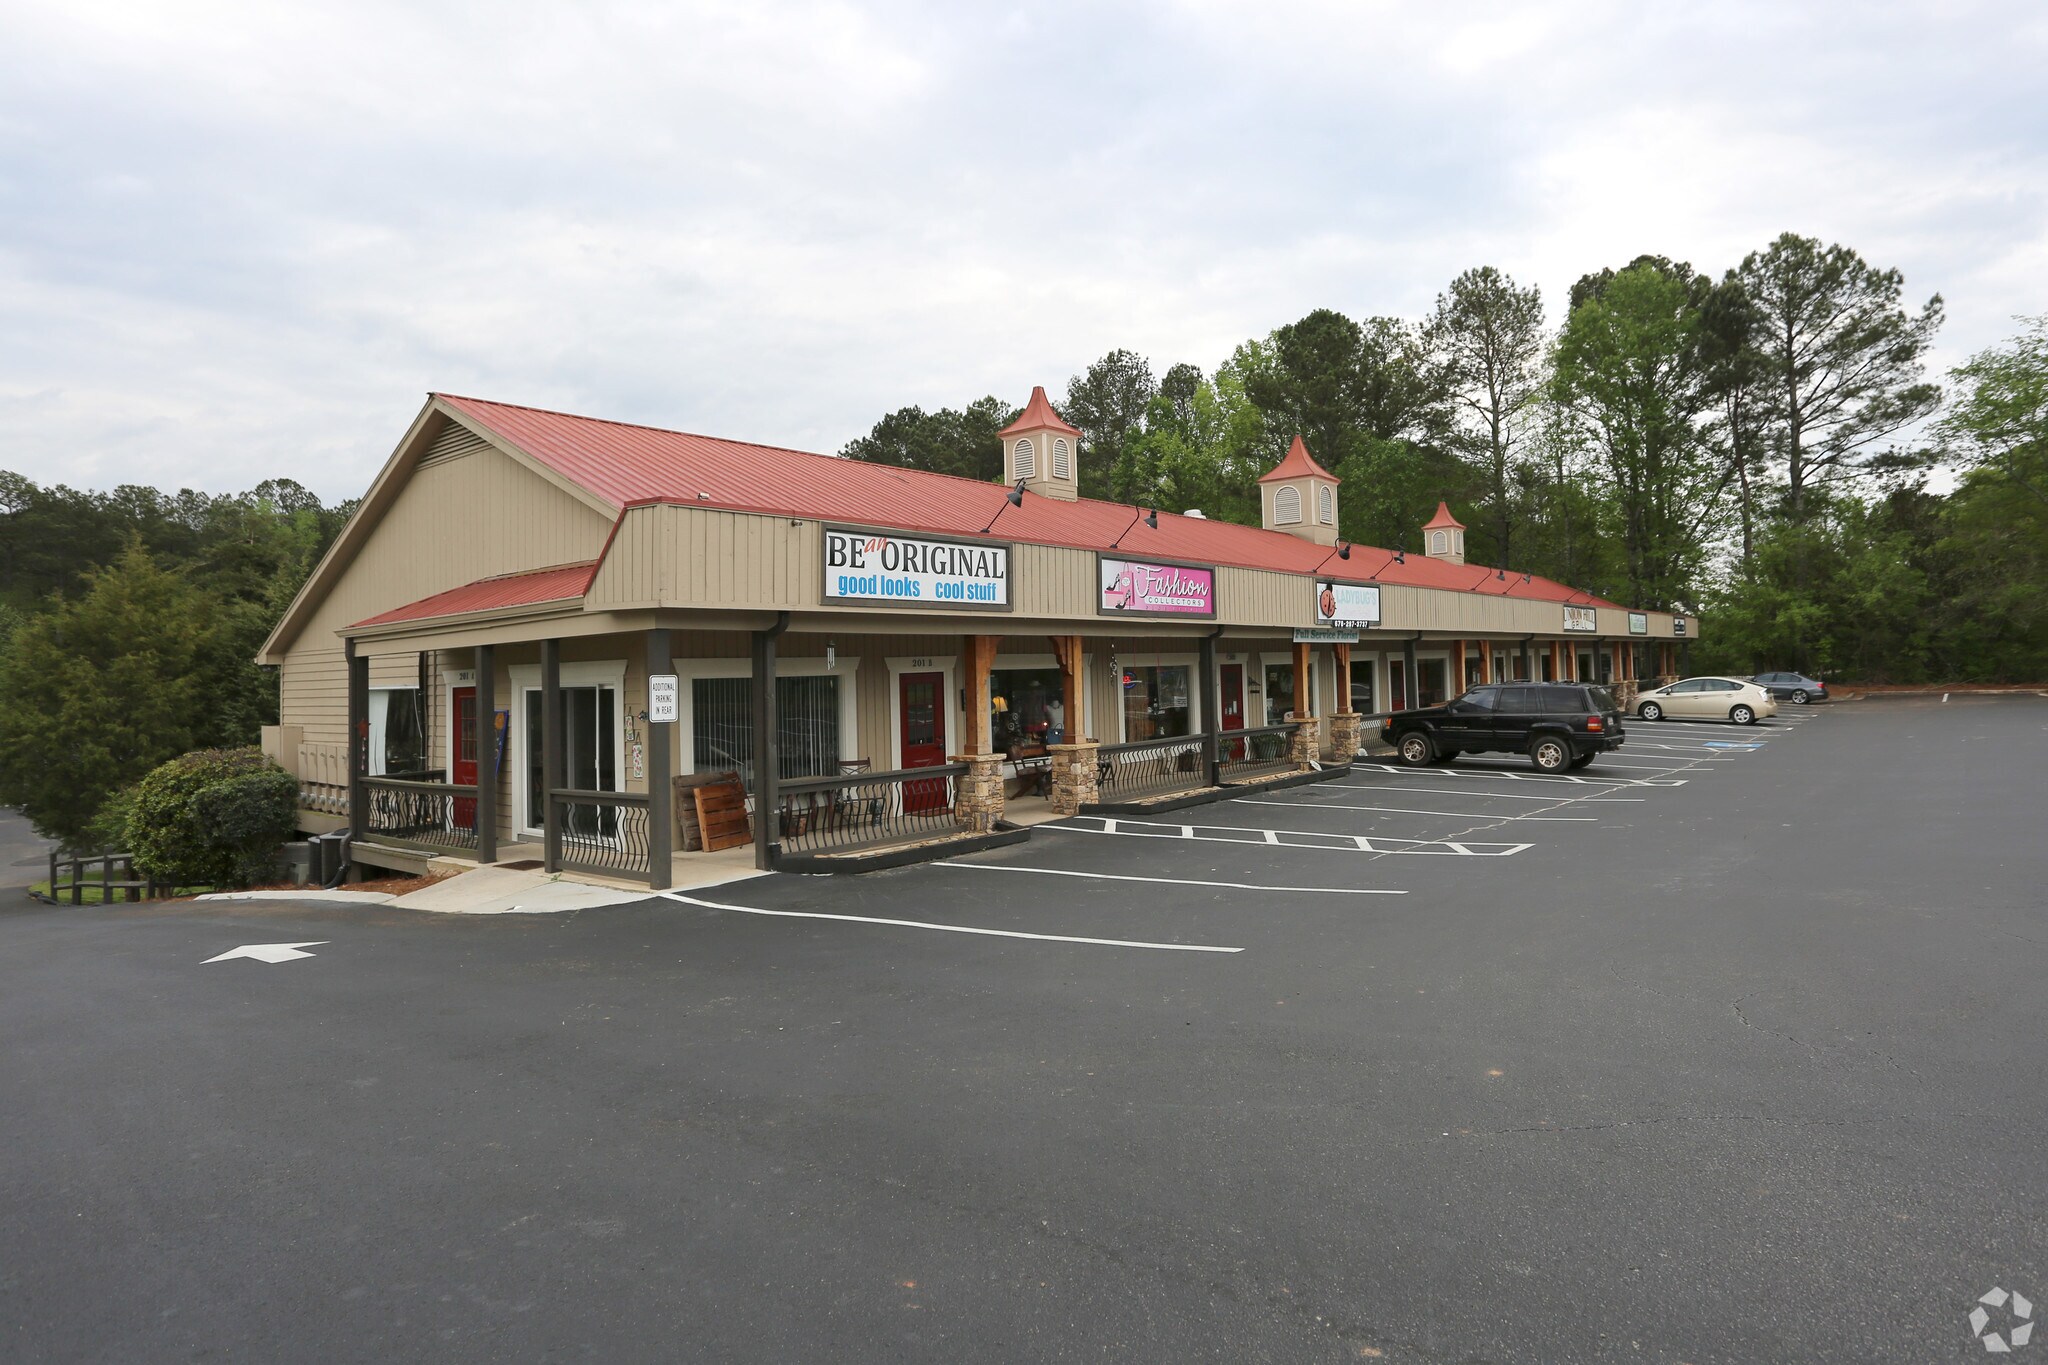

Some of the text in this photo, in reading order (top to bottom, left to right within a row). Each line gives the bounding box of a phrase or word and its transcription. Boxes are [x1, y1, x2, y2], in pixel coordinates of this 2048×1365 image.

[828, 535, 1004, 579] BE an ORIGINAL
[1135, 565, 1209, 598] Fashion
[838, 575, 997, 601] good looks cool stuff
[1148, 597, 1202, 606] COLLECTORS
[1335, 589, 1377, 605] LADYBUG'S
[1295, 629, 1358, 640] Full Service Florist
[912, 659, 925, 667] 201
[653, 682, 675, 691] ADDITIONAL
[656, 694, 672, 703] PARKING
[662, 705, 672, 715] REAR
